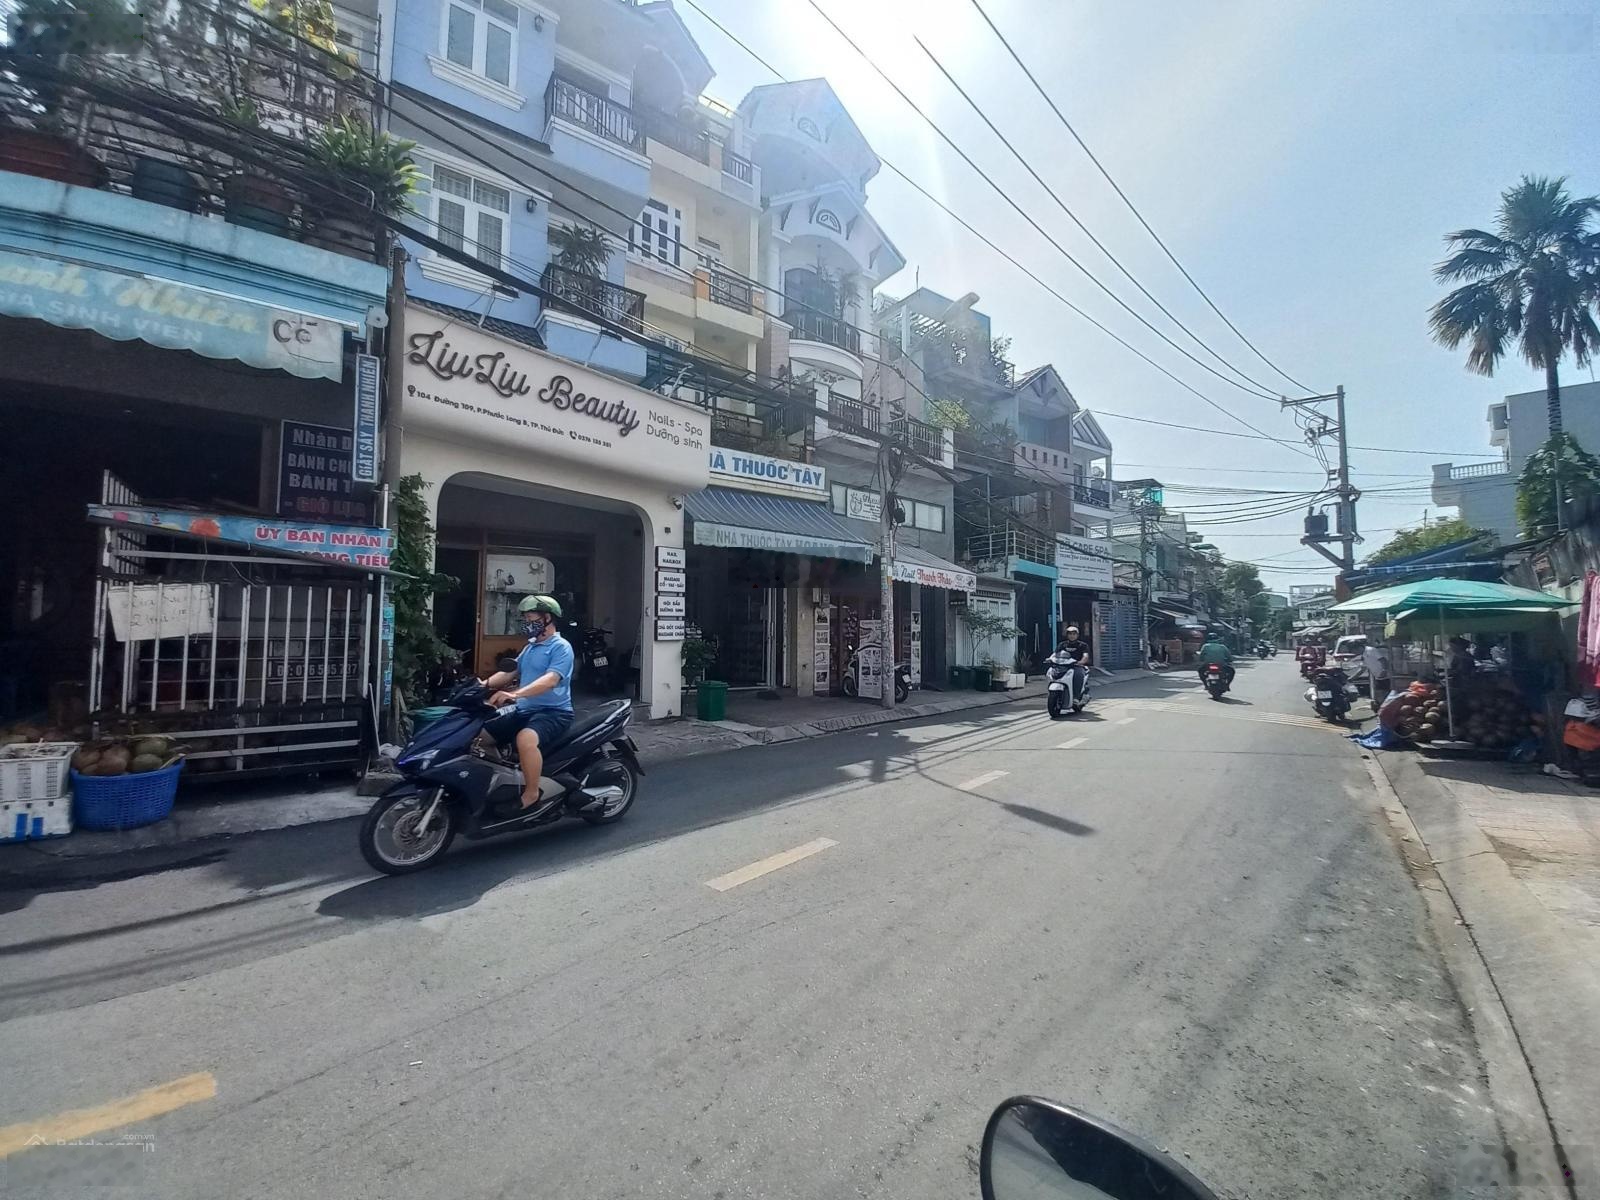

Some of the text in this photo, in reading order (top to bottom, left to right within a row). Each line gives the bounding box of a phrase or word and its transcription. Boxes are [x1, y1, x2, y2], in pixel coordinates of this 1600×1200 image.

[417, 391, 431, 400] 104
[538, 375, 640, 437] Beauty
[359, 393, 375, 427] THANH
[649, 410, 675, 427] Nails
[685, 422, 702, 436] Spa
[646, 424, 703, 450] Dưỡng sinh
[287, 452, 325, 470] BÁNH
[732, 456, 788, 480] THUỐC
[792, 468, 821, 486] TÂY
[256, 525, 281, 540] ỦY
[287, 530, 325, 543] BAN
[331, 531, 382, 547] NHÂN
